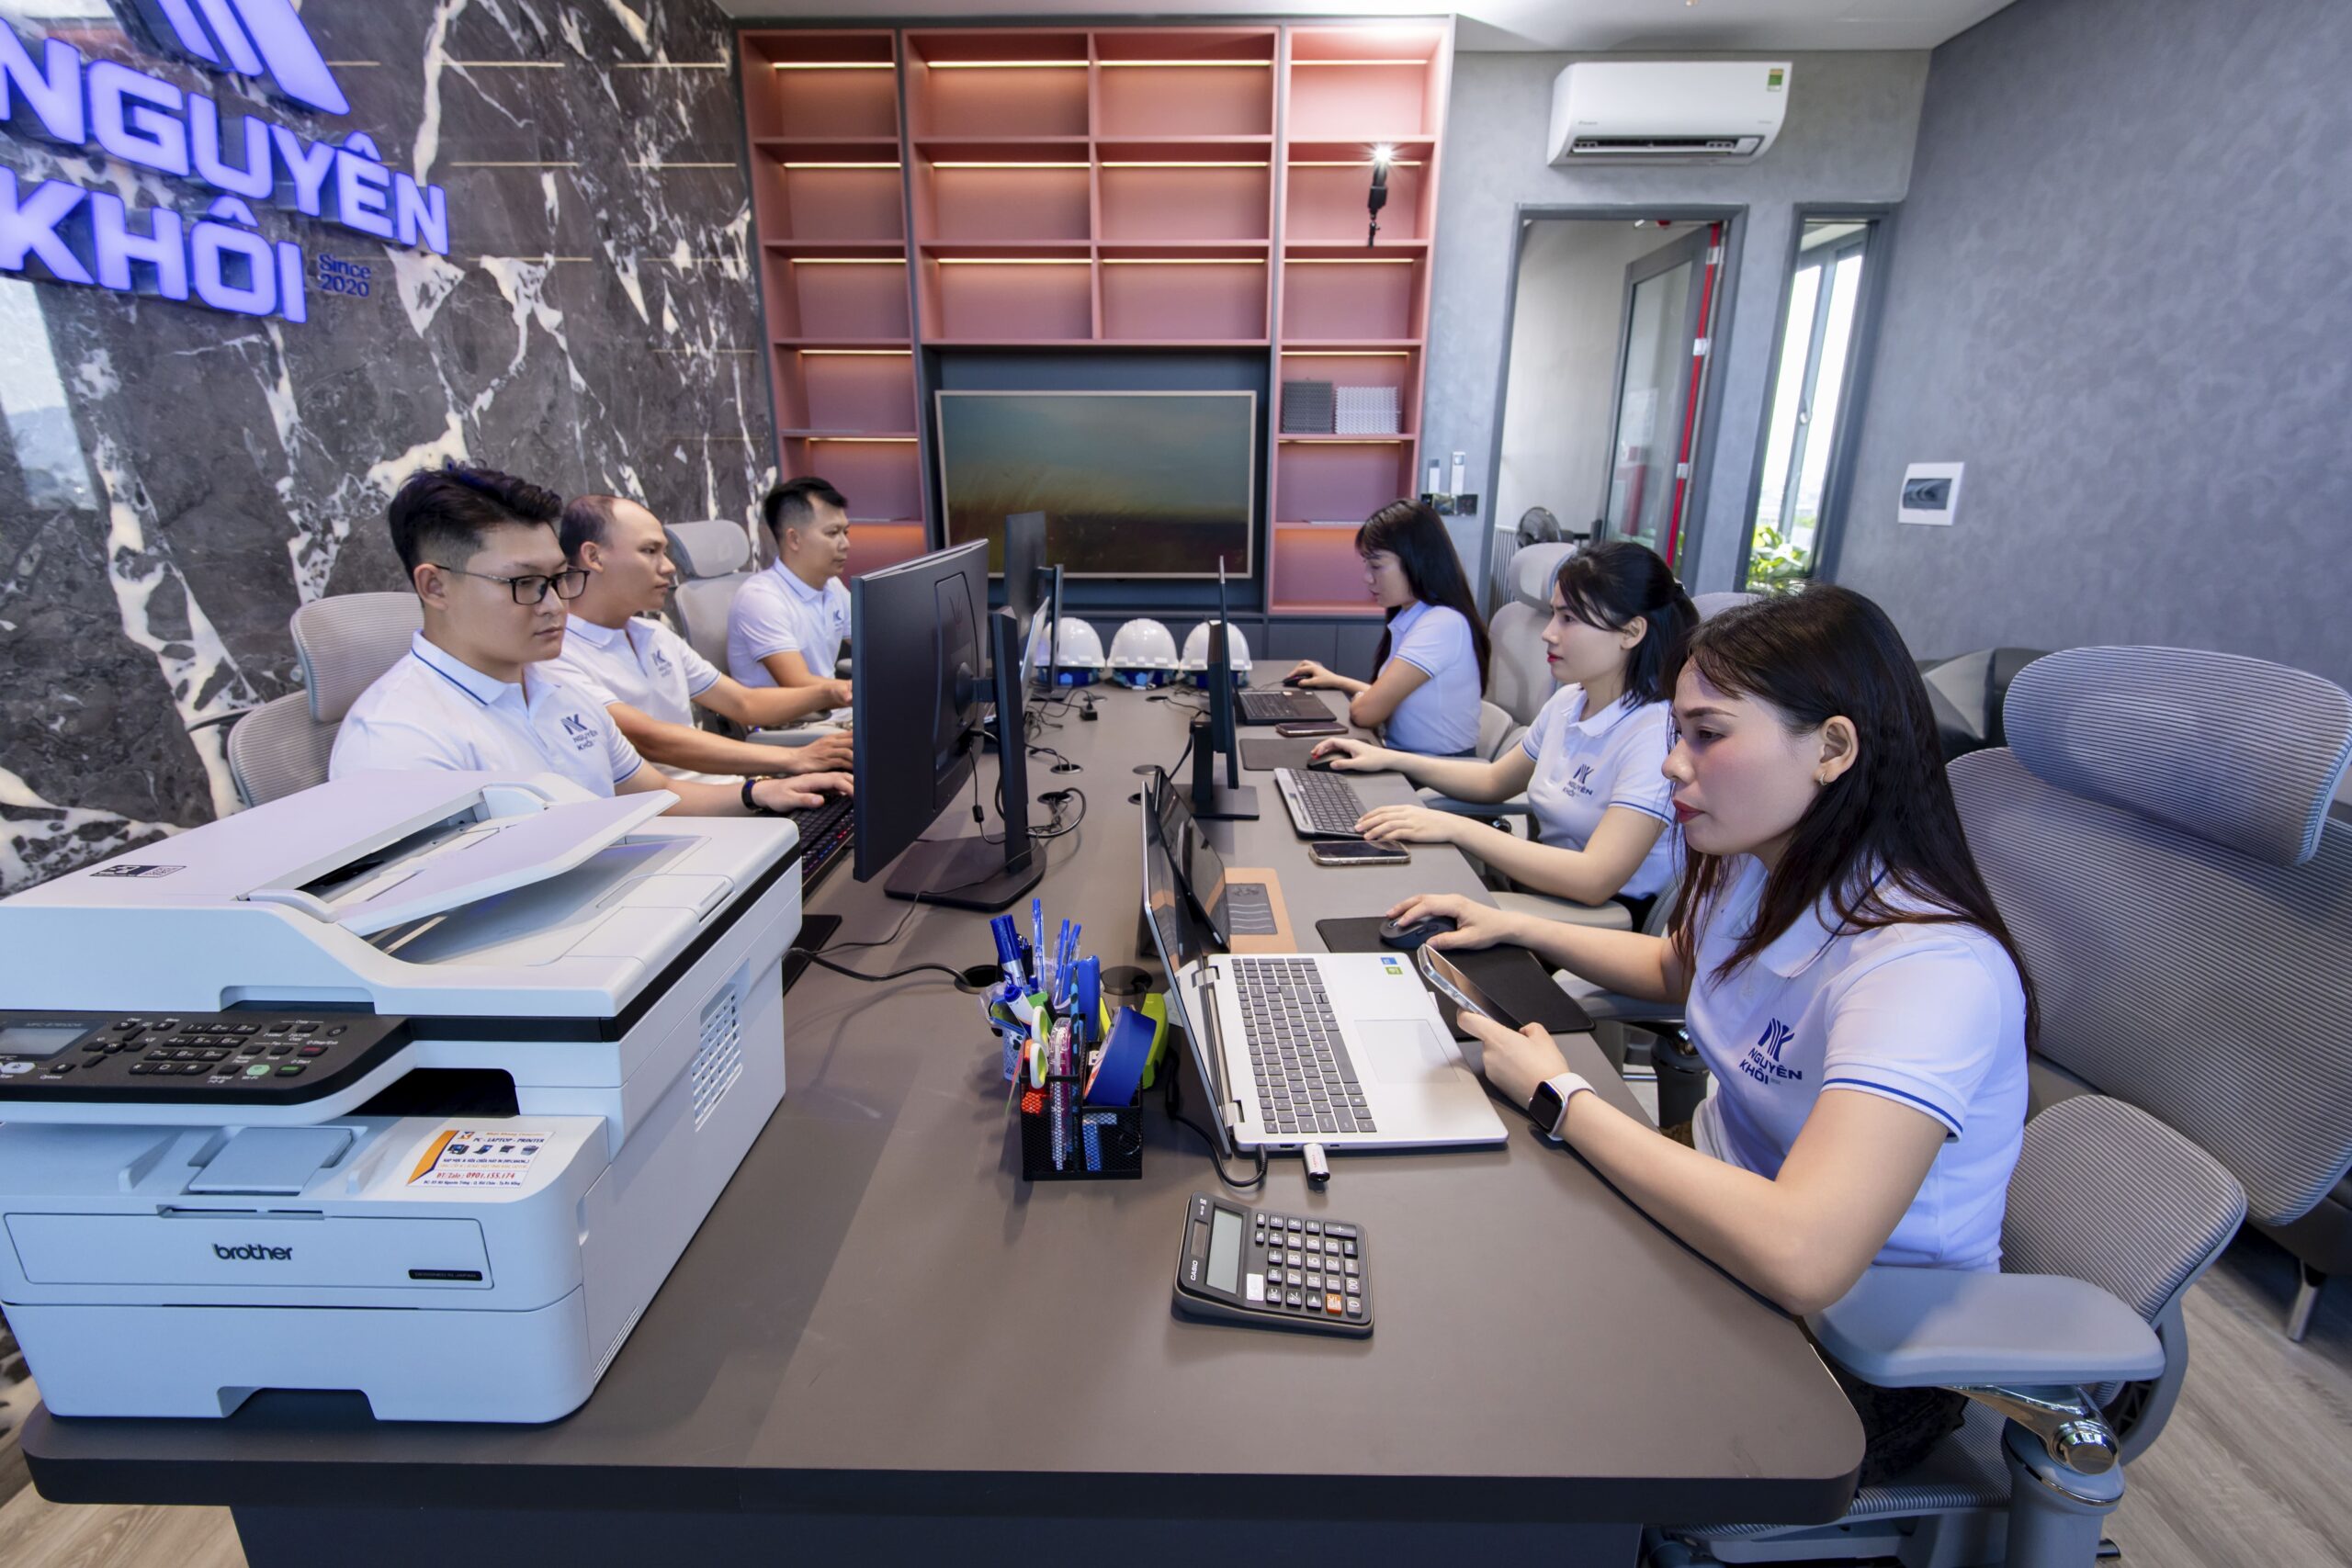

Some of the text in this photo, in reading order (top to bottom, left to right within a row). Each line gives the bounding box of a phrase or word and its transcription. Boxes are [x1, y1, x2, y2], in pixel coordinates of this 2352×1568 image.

[0, 17, 448, 254] NGUYÊN
[0, 165, 307, 322] KHÔI
[319, 254, 371, 279] Since
[319, 273, 369, 297] 2020
[1739, 1059, 1769, 1084] KHÔI
[1747, 1047, 1802, 1080] NGUYÊN
[213, 1244, 293, 1260] brother
[1190, 1259, 1198, 1280] CASIO
